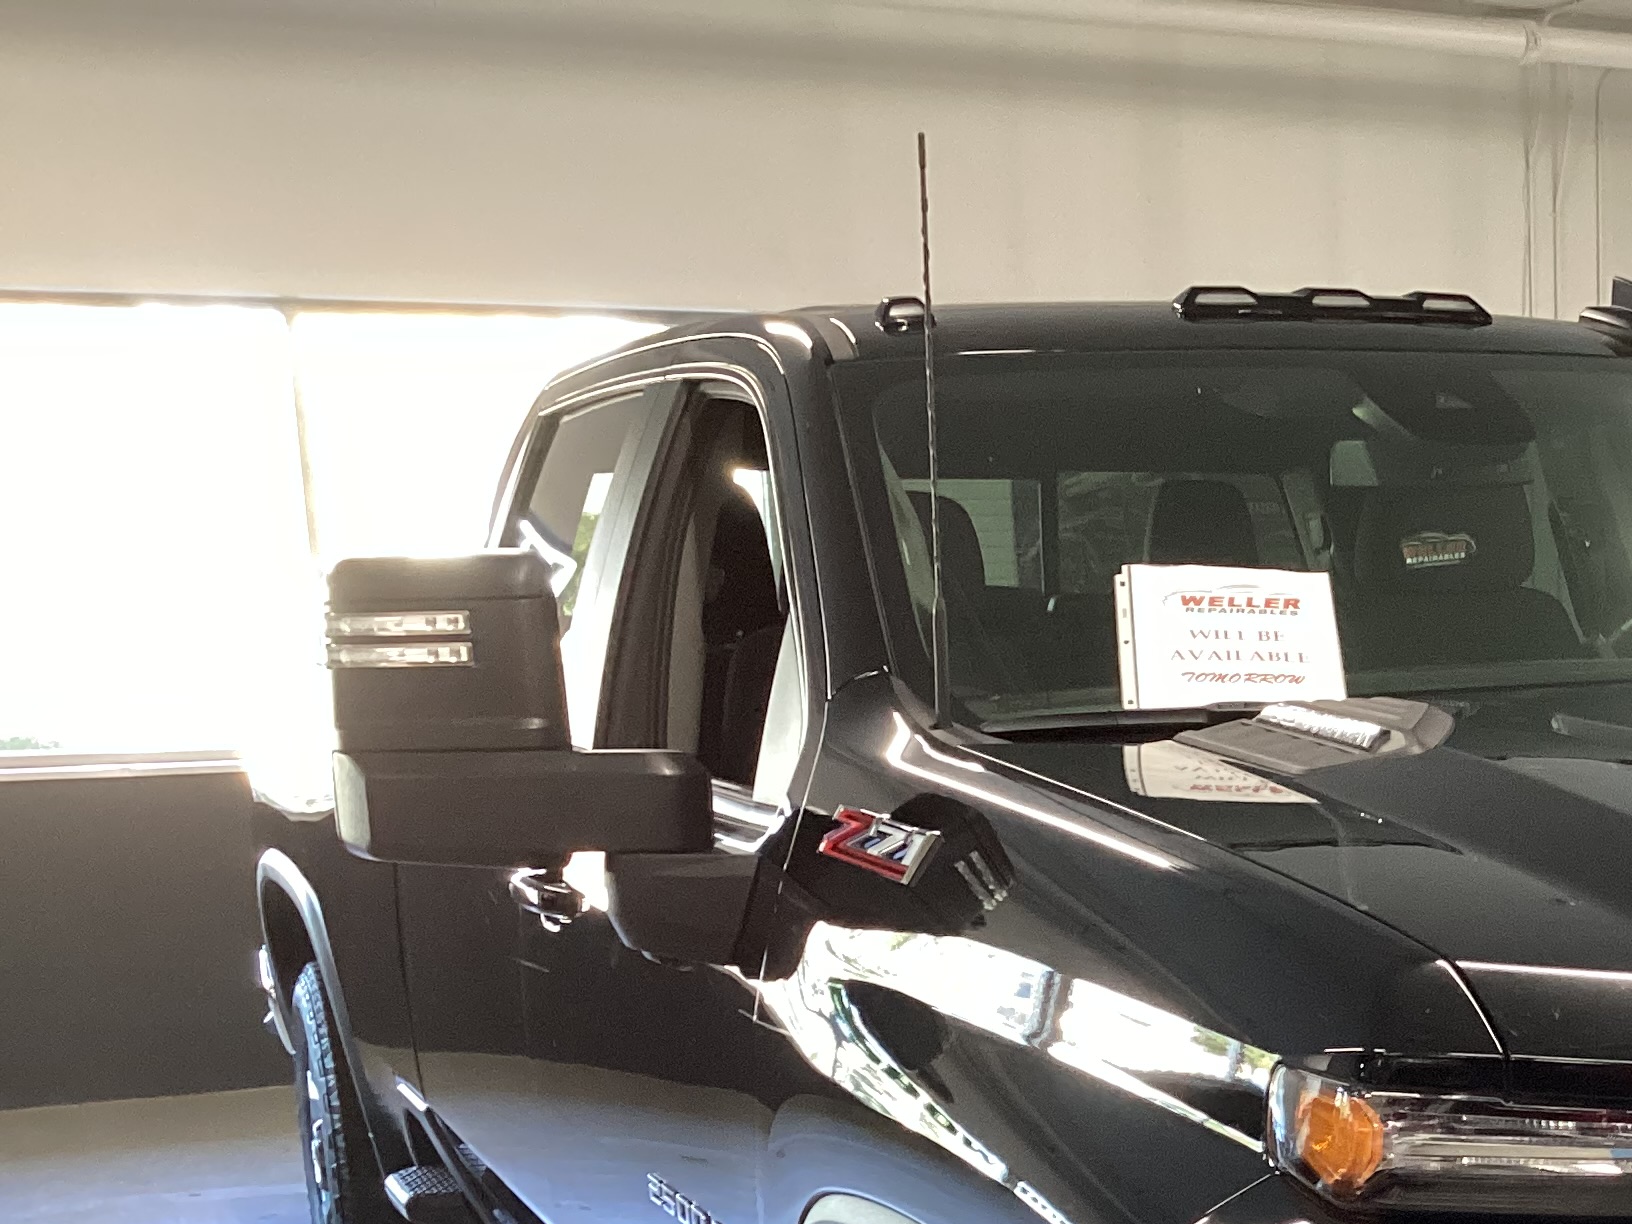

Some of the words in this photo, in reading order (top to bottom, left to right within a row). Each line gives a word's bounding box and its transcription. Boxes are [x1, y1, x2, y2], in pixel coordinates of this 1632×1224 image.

[1180, 594, 1301, 609] WELLER
[1185, 606, 1299, 616] REPAIRABLES
[1189, 629, 1244, 641] WILL
[1258, 630, 1285, 642] BE
[1170, 649, 1311, 664] AVAILABLE
[1180, 671, 1306, 685] TOMORROW
[817, 804, 943, 886] Z71
